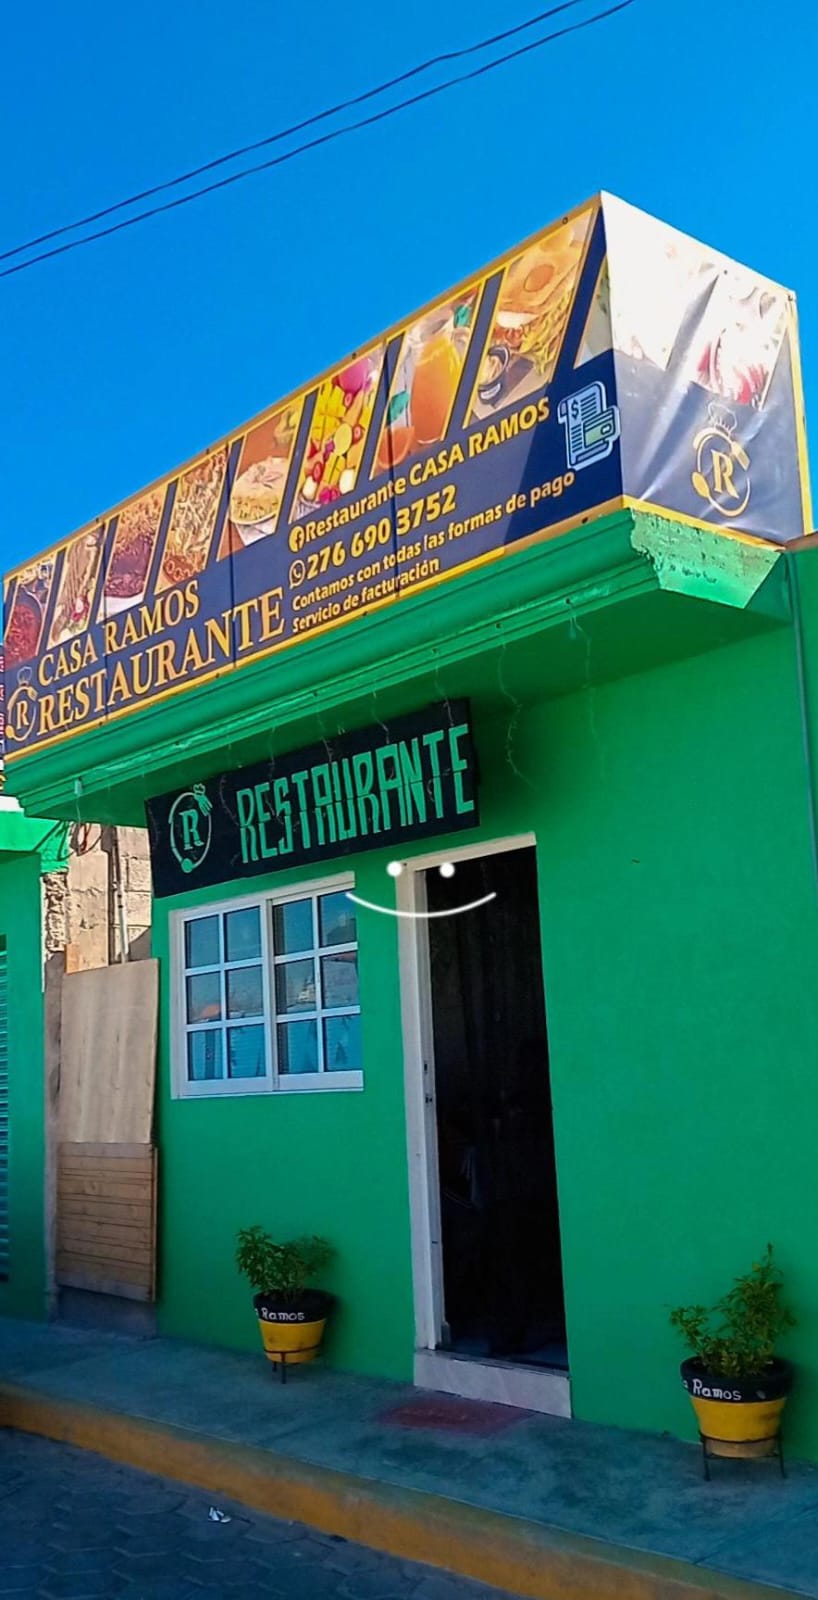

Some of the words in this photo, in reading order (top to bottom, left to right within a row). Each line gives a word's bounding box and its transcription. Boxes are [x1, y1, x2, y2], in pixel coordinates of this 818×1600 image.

[306, 477, 406, 542] Restaurante
[409, 444, 464, 486] CASA
[469, 397, 549, 457] RAMOS
[711, 450, 739, 499] R
[292, 575, 354, 611] Contamos
[357, 563, 380, 583] con
[384, 541, 421, 570] todas
[424, 530, 445, 551] las
[448, 505, 502, 540] formas
[506, 493, 526, 513] de
[530, 471, 575, 508] pago
[307, 541, 345, 580] 276
[351, 518, 391, 557] 690
[396, 485, 456, 536] 3752
[38, 634, 98, 687] CASA
[102, 580, 200, 656] RAMOS
[292, 600, 340, 633] Servicio
[343, 592, 359, 611] de
[361, 557, 440, 607] facturación
[37, 587, 286, 736] RESTAURANTE
[236, 723, 474, 863] RESTAURANTE
[261, 1307, 305, 1321] Ramos
[692, 1378, 742, 1401] Ramos
